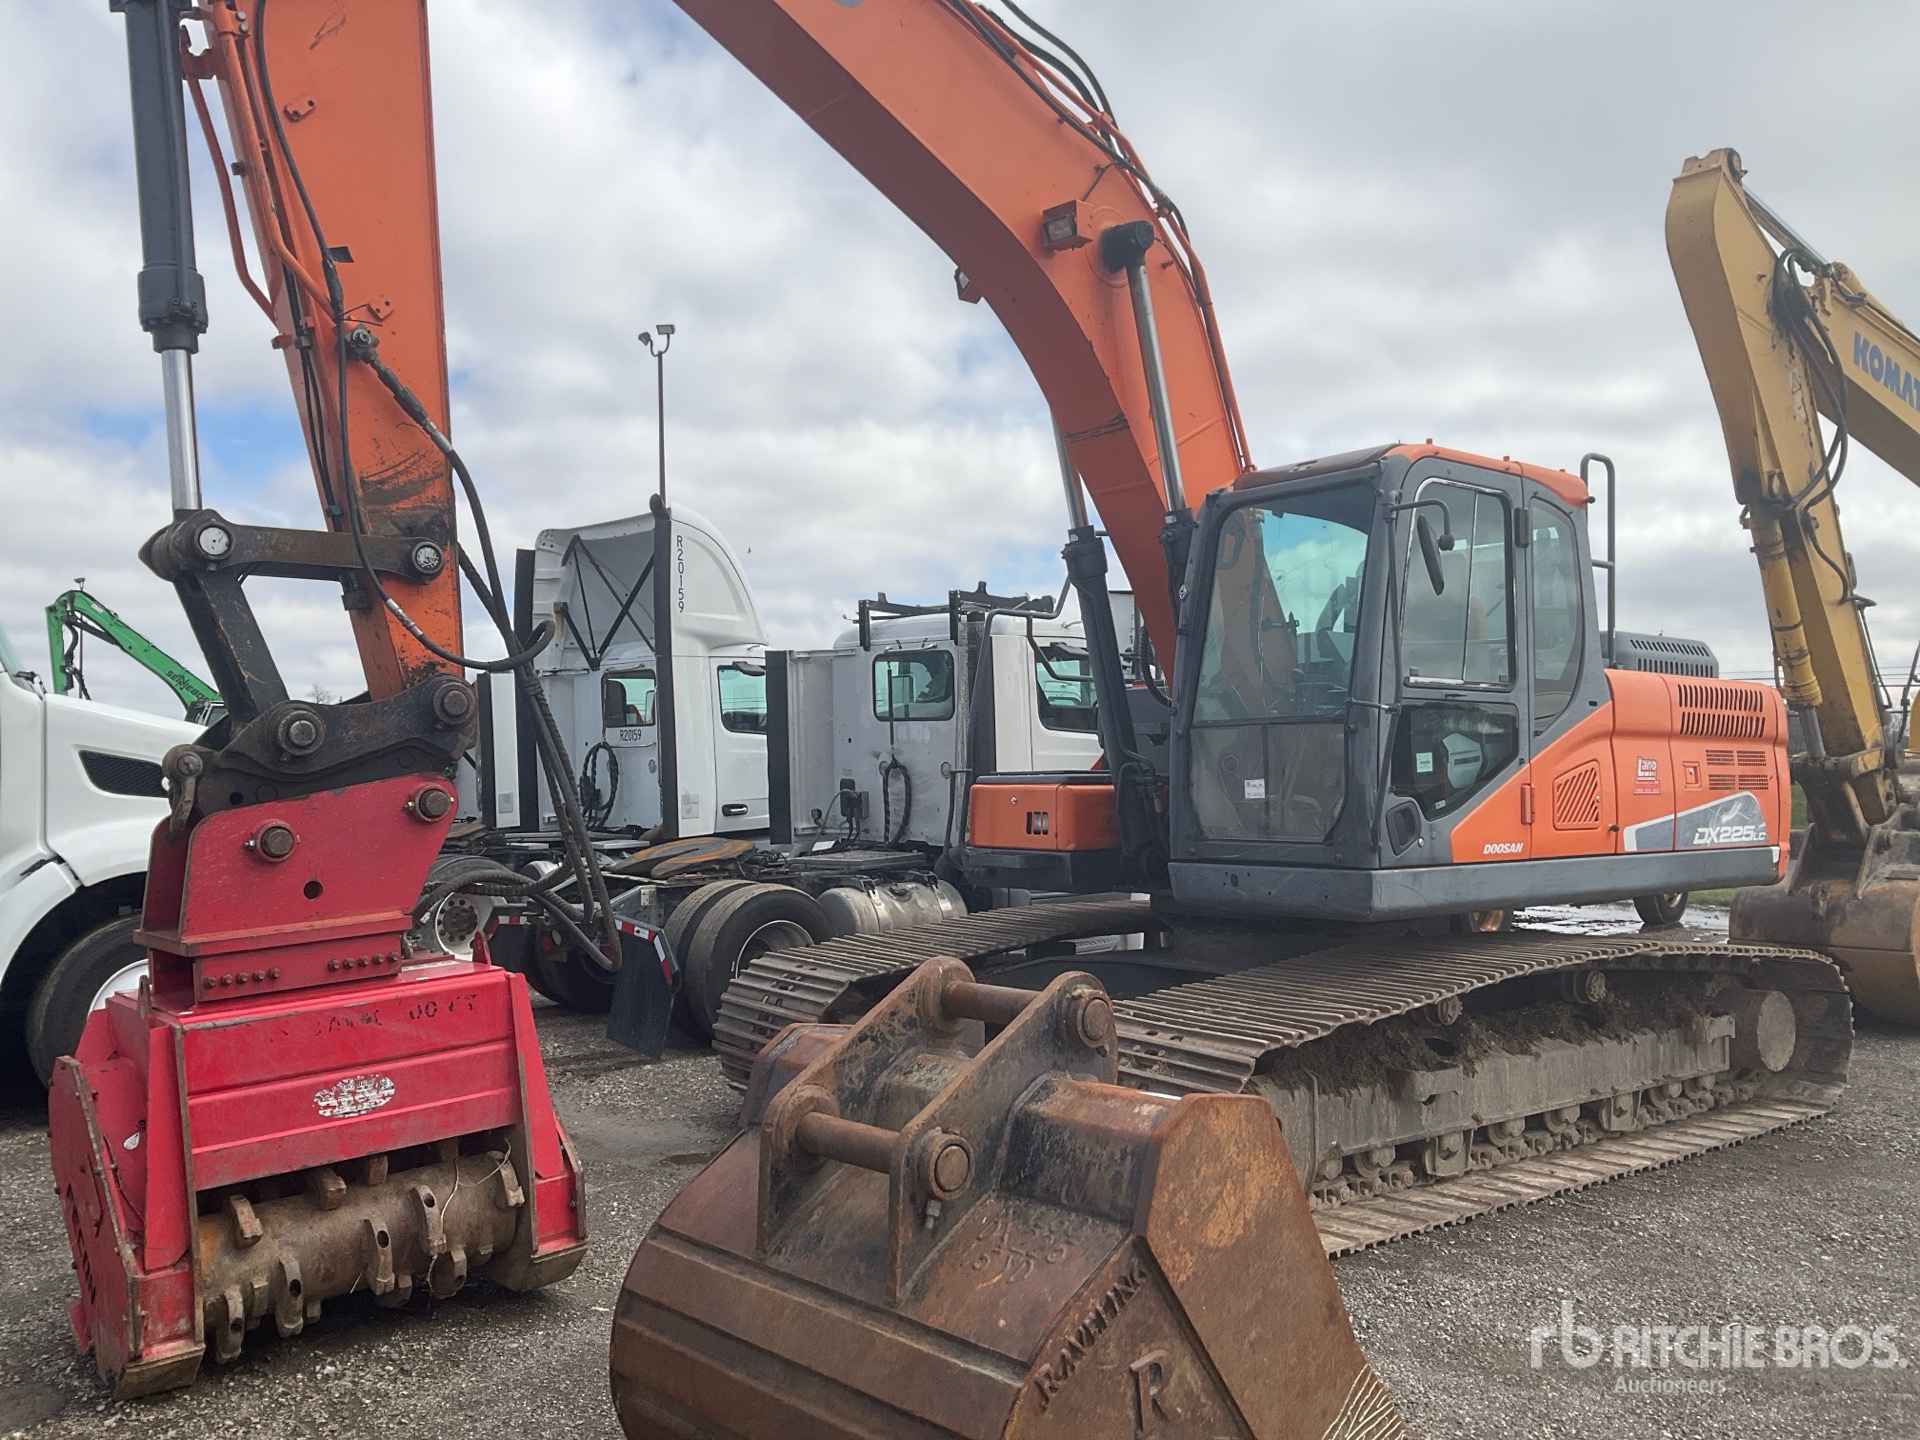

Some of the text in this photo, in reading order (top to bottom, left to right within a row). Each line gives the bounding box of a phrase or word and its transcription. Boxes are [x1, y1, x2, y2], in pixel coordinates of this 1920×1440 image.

[676, 535, 685, 612] R20159
[619, 729, 642, 741] R20159
[1483, 843, 1524, 854] DOOSAN
